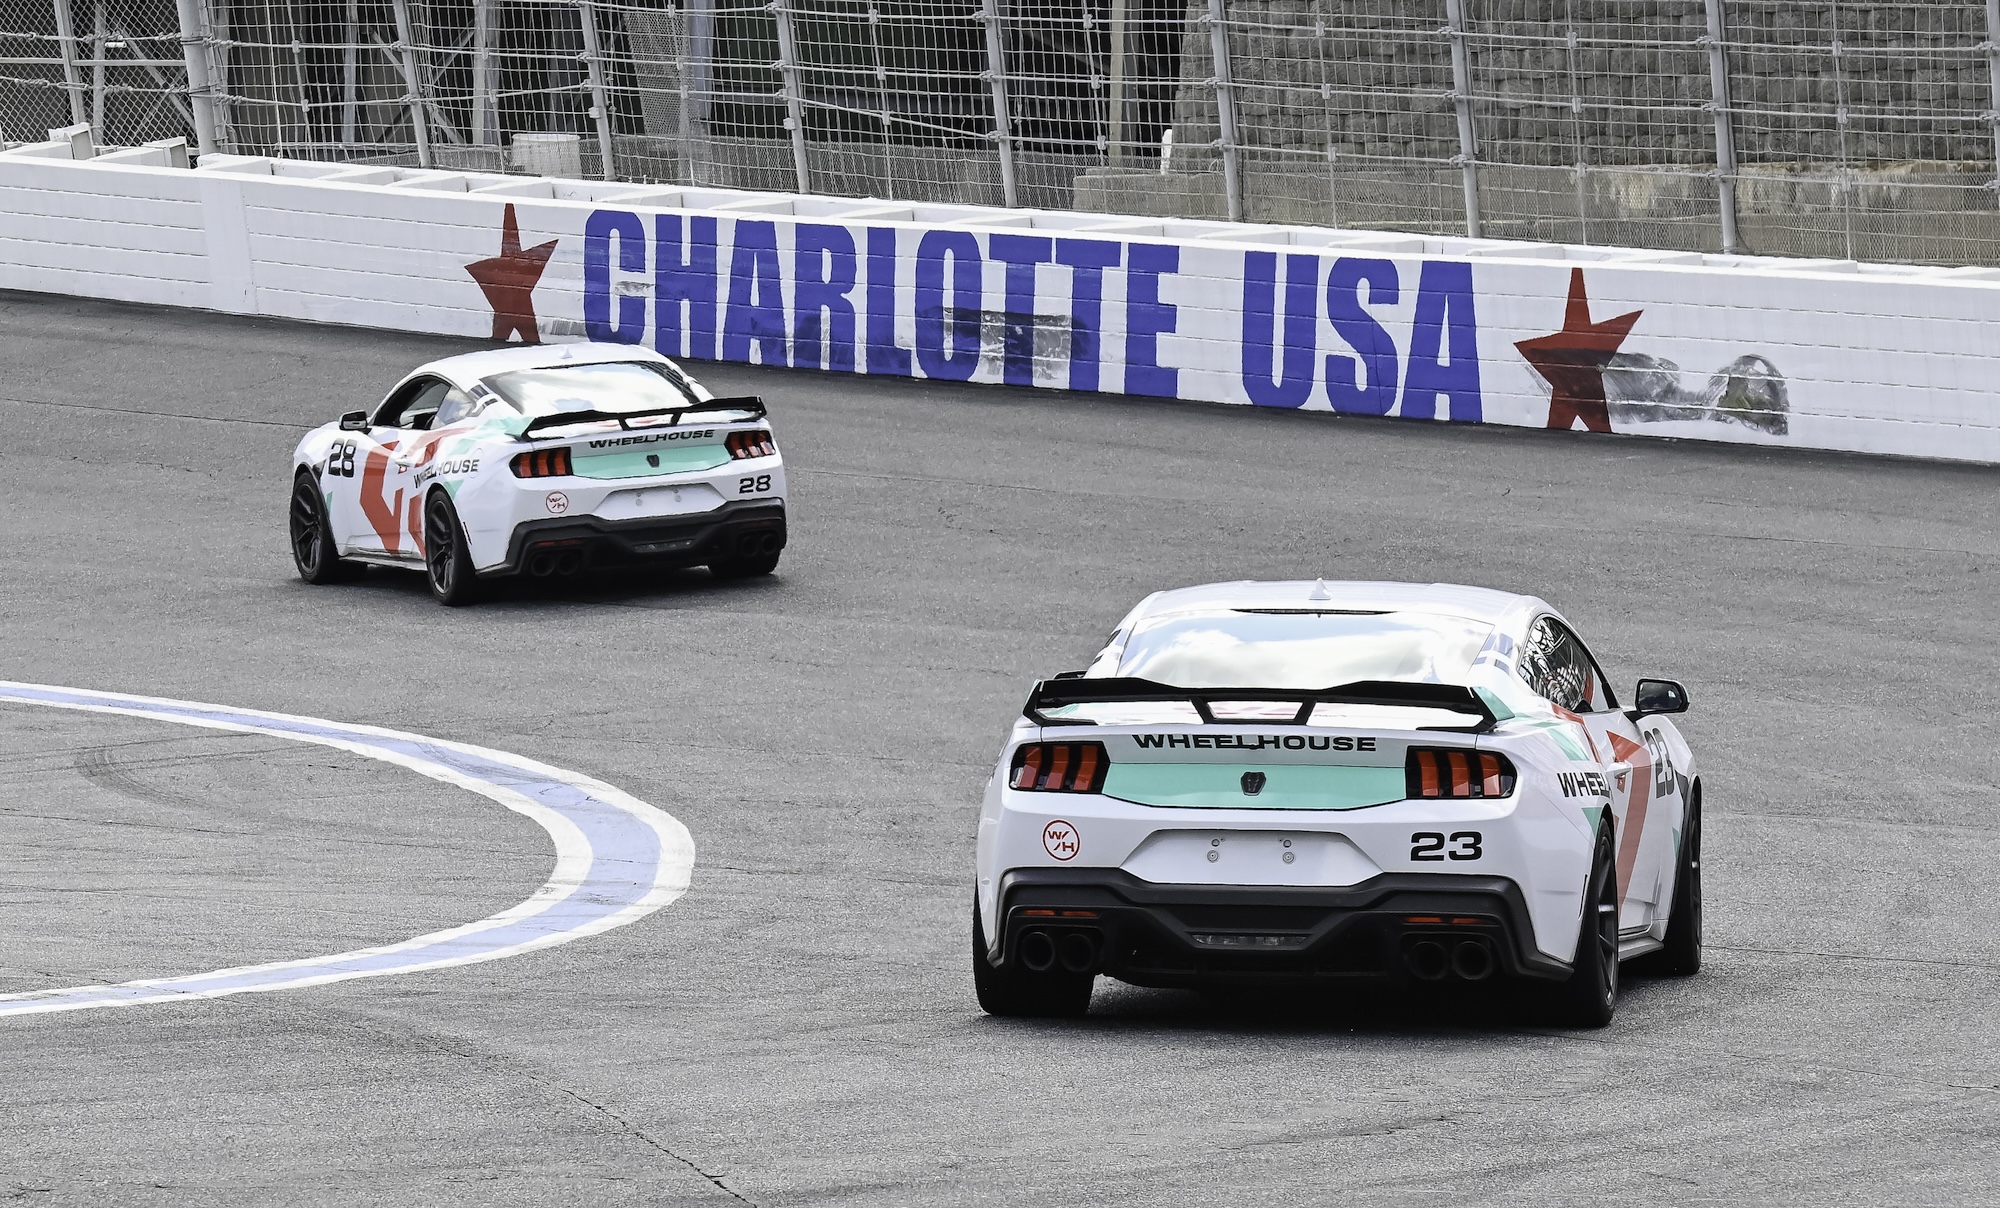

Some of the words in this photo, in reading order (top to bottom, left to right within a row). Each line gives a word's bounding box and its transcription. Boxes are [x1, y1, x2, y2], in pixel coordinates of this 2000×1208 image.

[583, 209, 1180, 398] CHARLOTTE
[1242, 251, 1483, 422] USA
[588, 429, 715, 450] WHEELHOUSE
[328, 438, 357, 478] 28
[739, 474, 772, 495] 28
[1131, 733, 1377, 752] WHEELHOUSE
[1643, 727, 1676, 799] 23
[1411, 831, 1483, 862] 23
